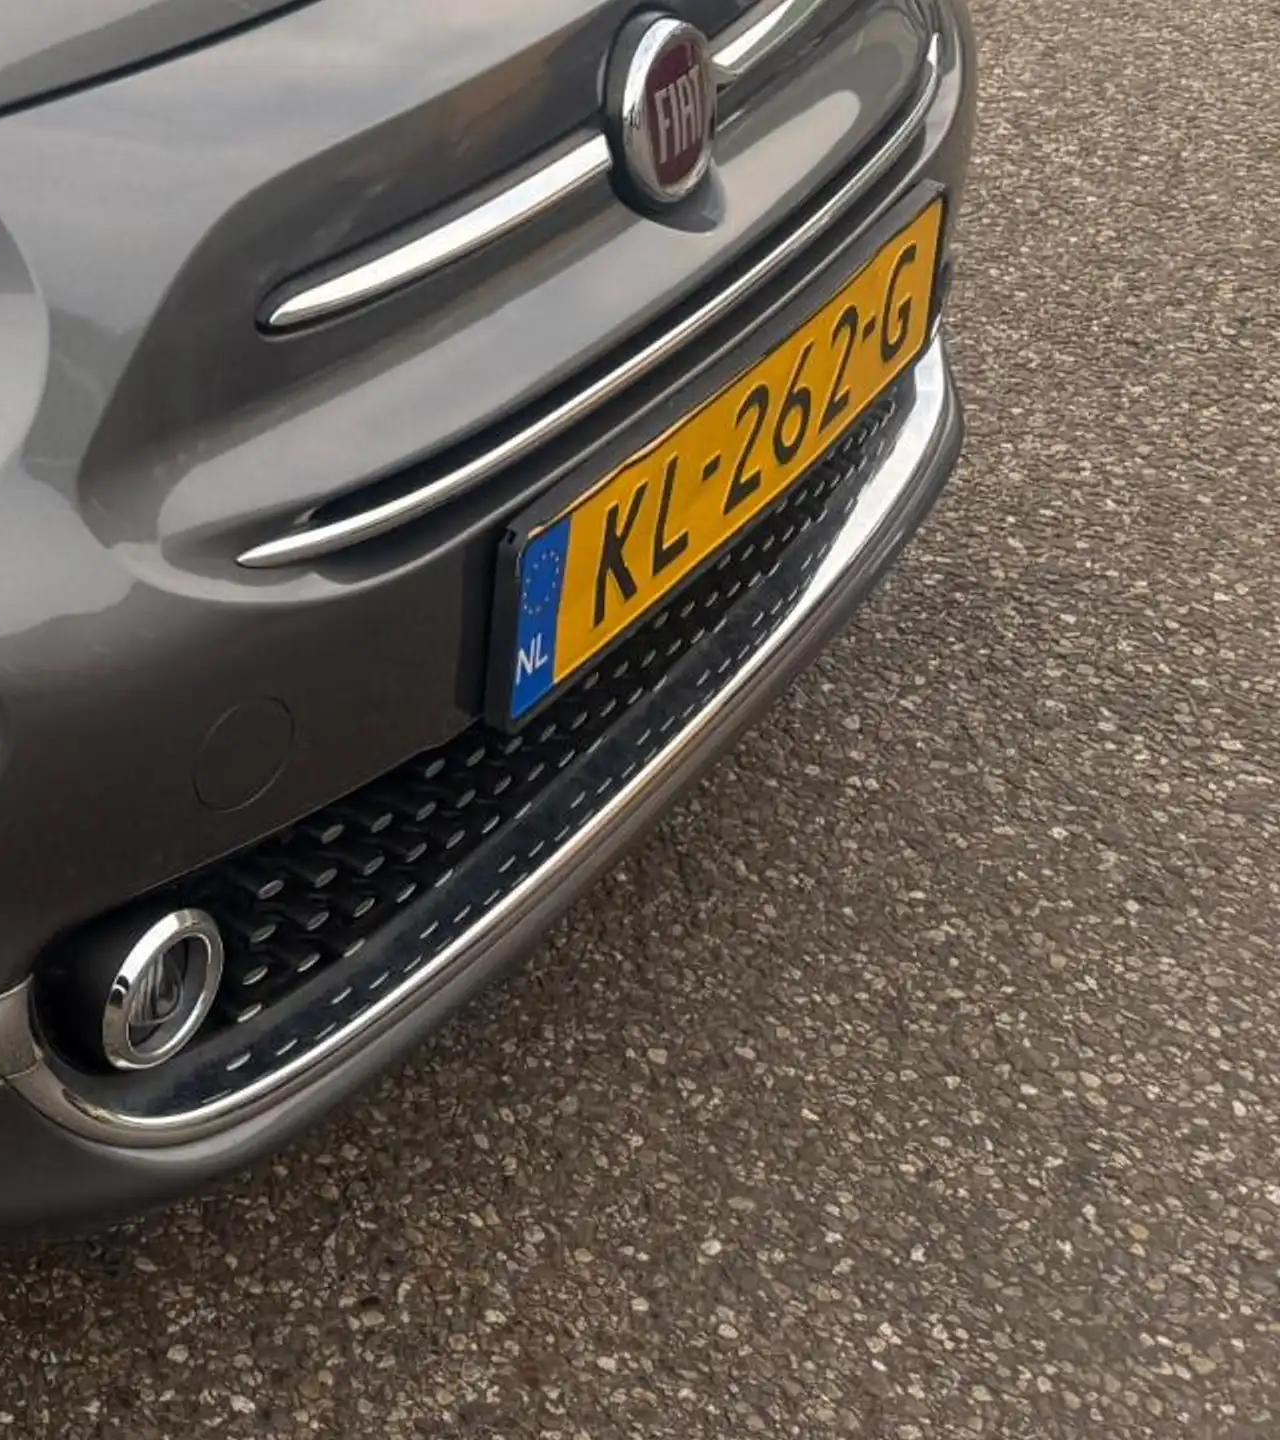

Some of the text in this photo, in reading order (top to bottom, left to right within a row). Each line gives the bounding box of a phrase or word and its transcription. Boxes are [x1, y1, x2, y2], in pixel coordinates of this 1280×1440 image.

[653, 63, 702, 165] FIAT
[592, 240, 918, 629] KL-262-G
[514, 632, 549, 686] NL
